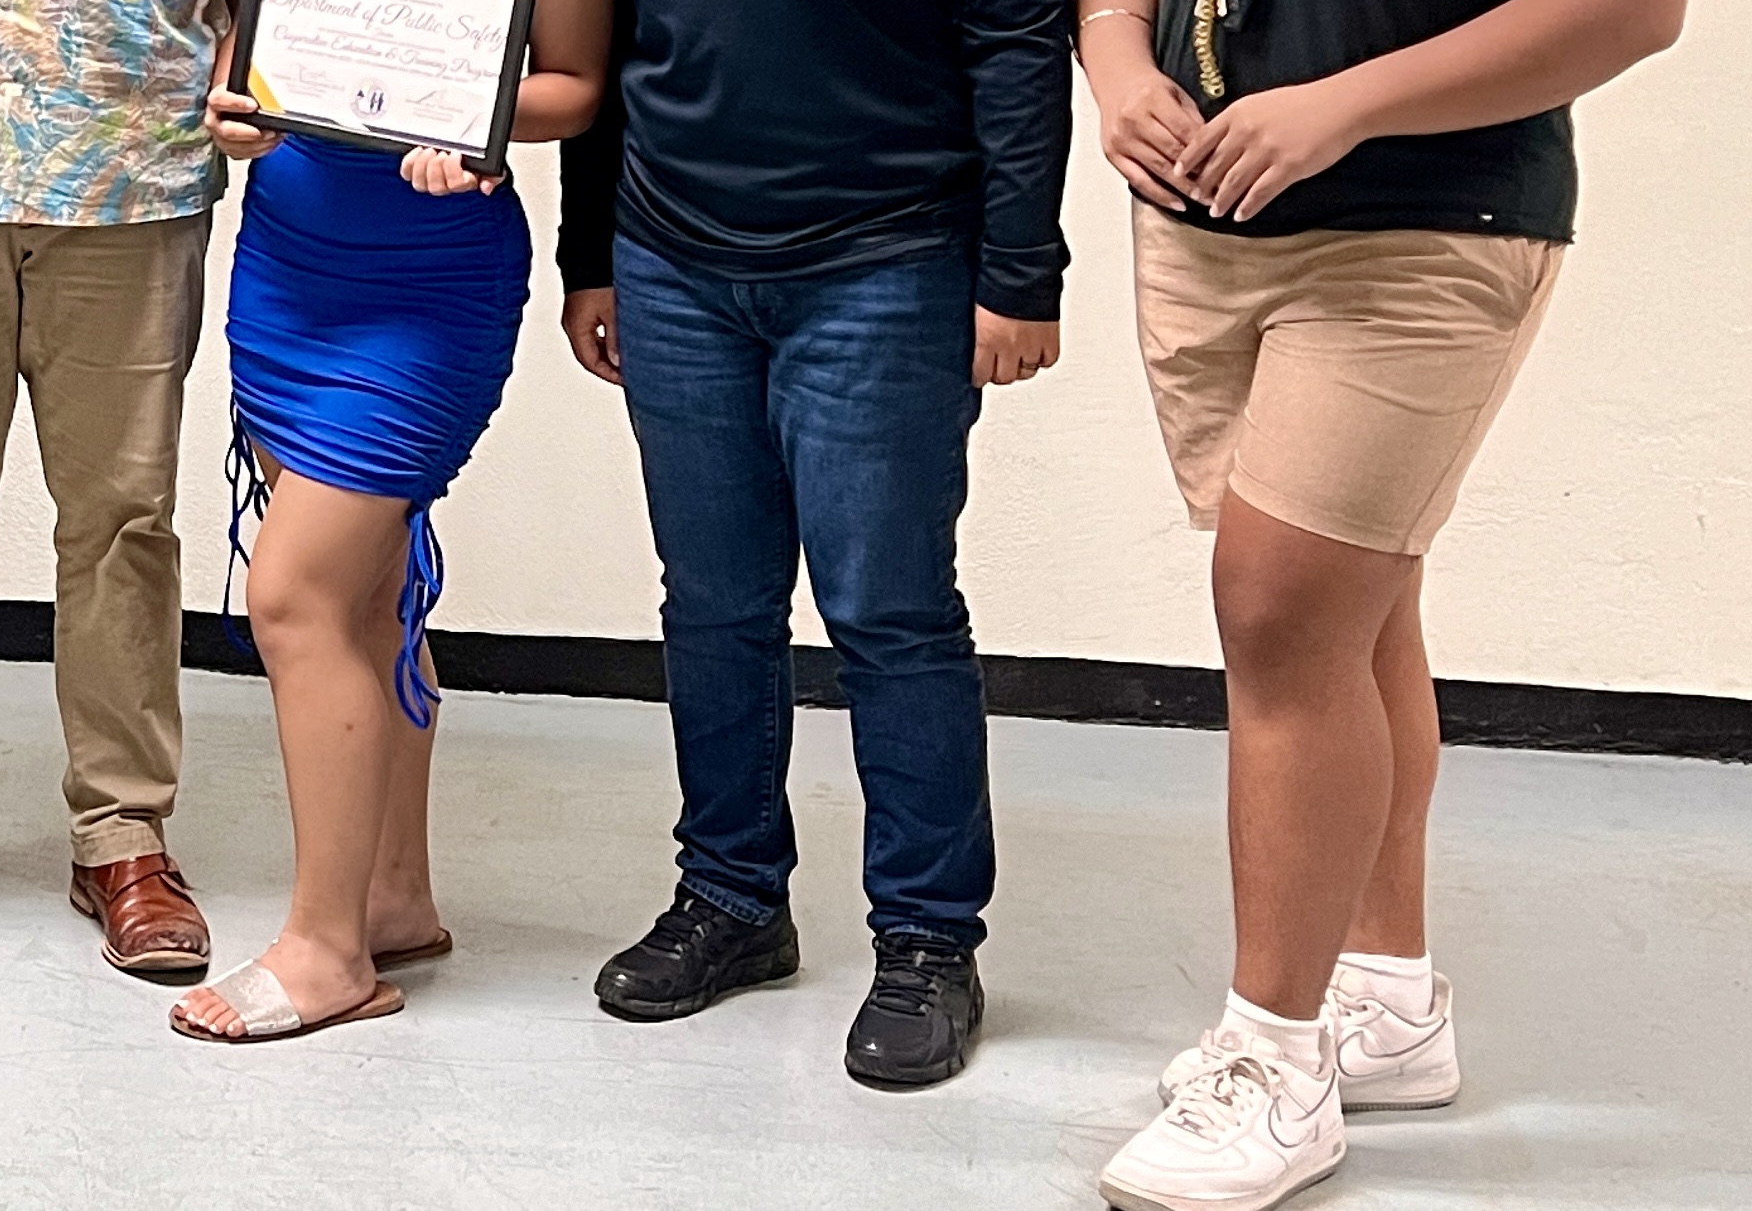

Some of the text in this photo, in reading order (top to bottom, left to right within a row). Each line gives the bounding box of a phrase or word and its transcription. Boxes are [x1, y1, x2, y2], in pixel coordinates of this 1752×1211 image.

[362, 4, 381, 30] of
[380, 2, 443, 34] Public
[445, 14, 507, 52] Safety
